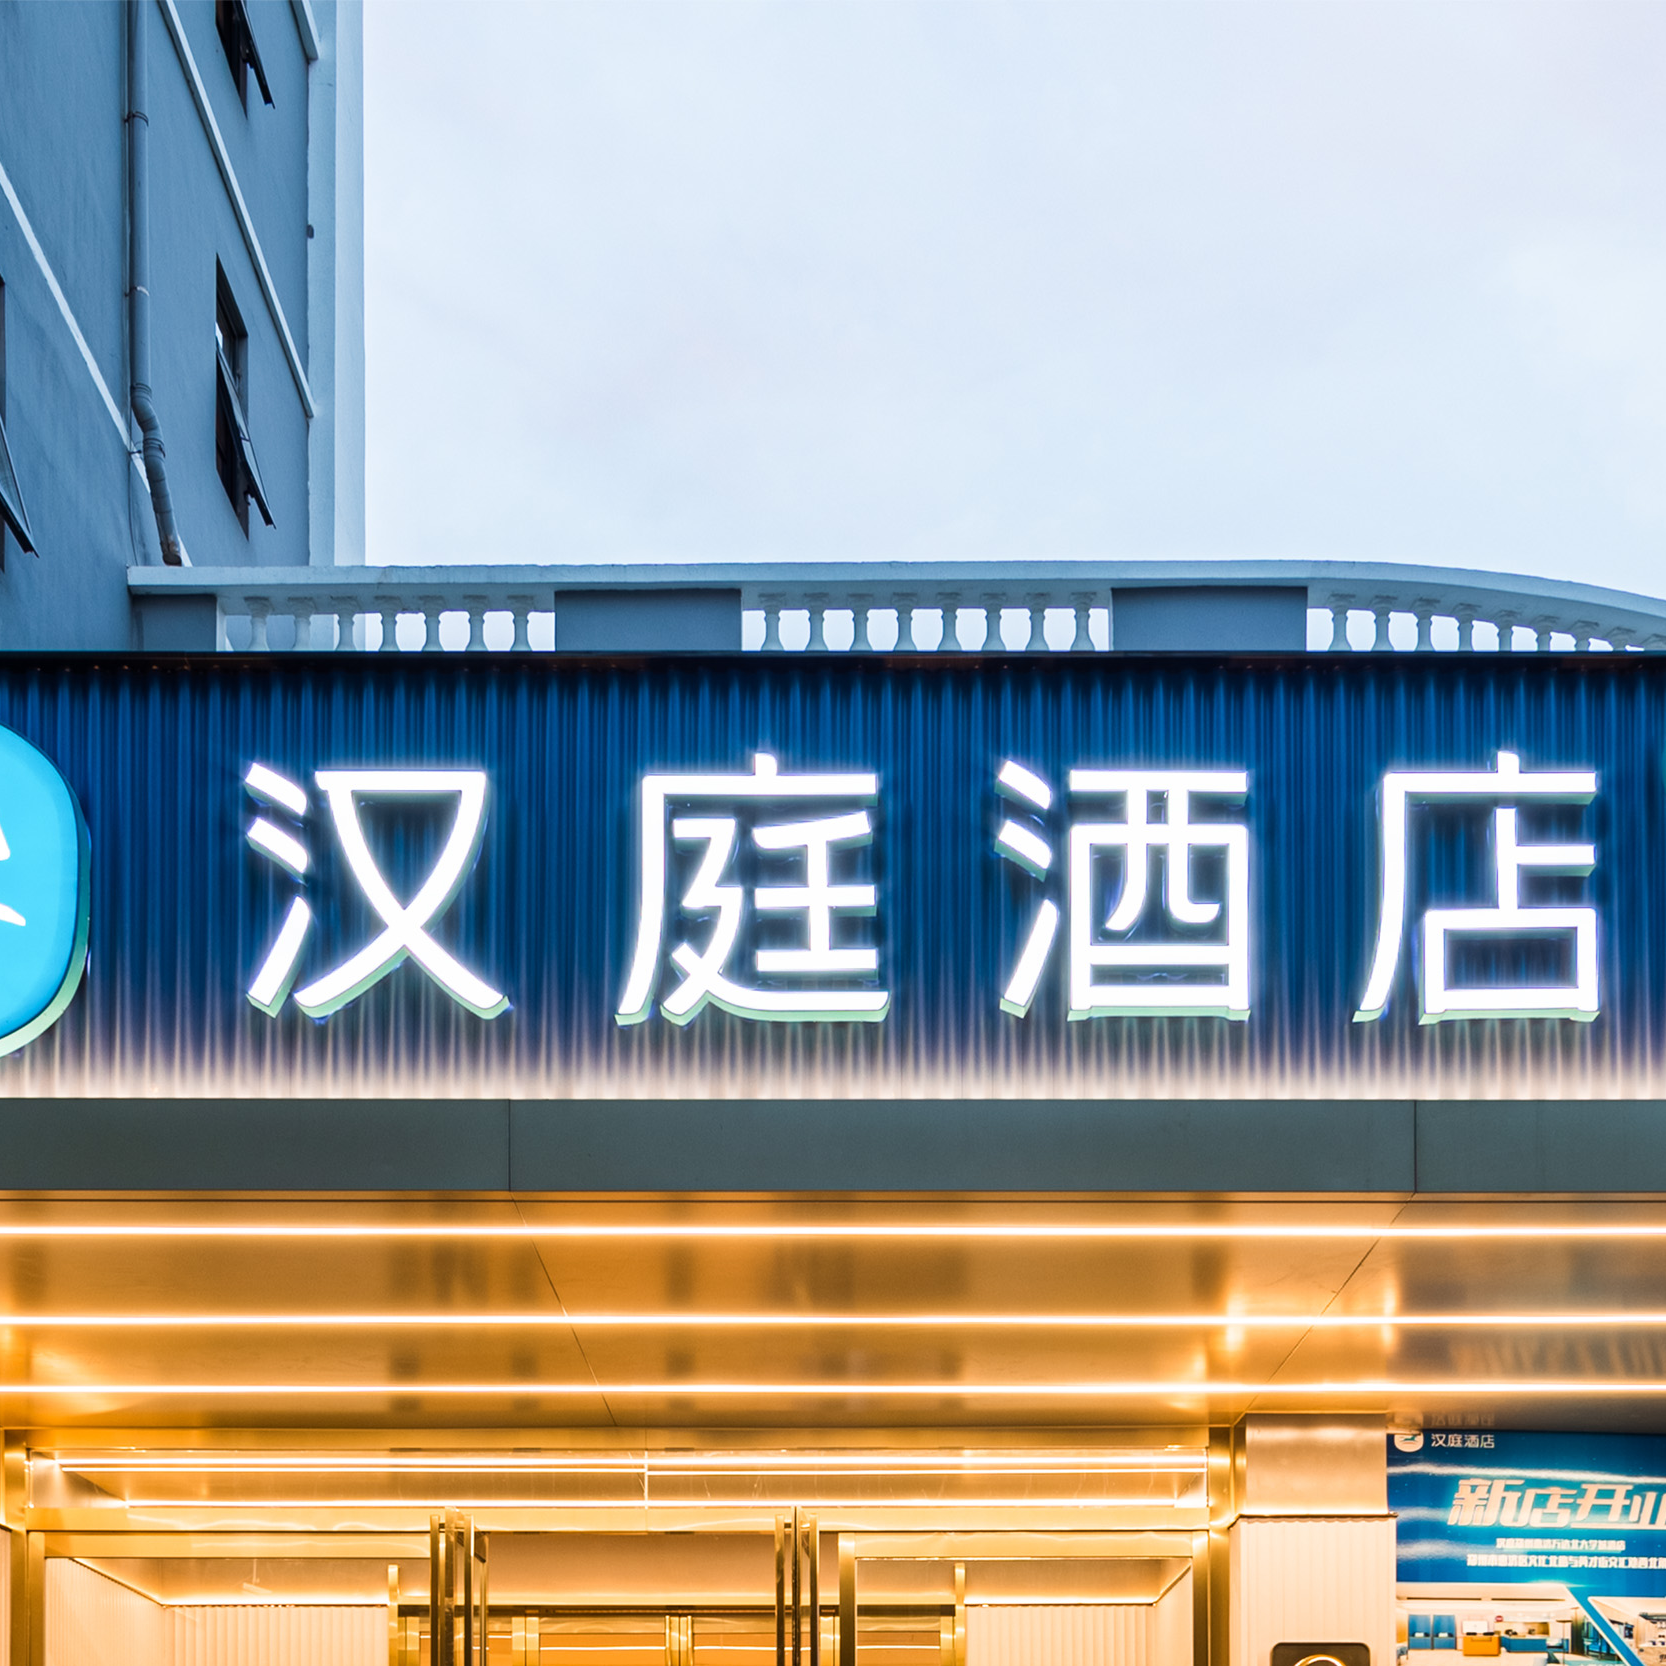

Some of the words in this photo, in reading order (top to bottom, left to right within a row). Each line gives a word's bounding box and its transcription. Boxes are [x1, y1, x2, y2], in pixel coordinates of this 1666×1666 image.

[243, 750, 1607, 1026] 汉庭酒店
[1431, 1433, 1495, 1449] 汉庭酒店
